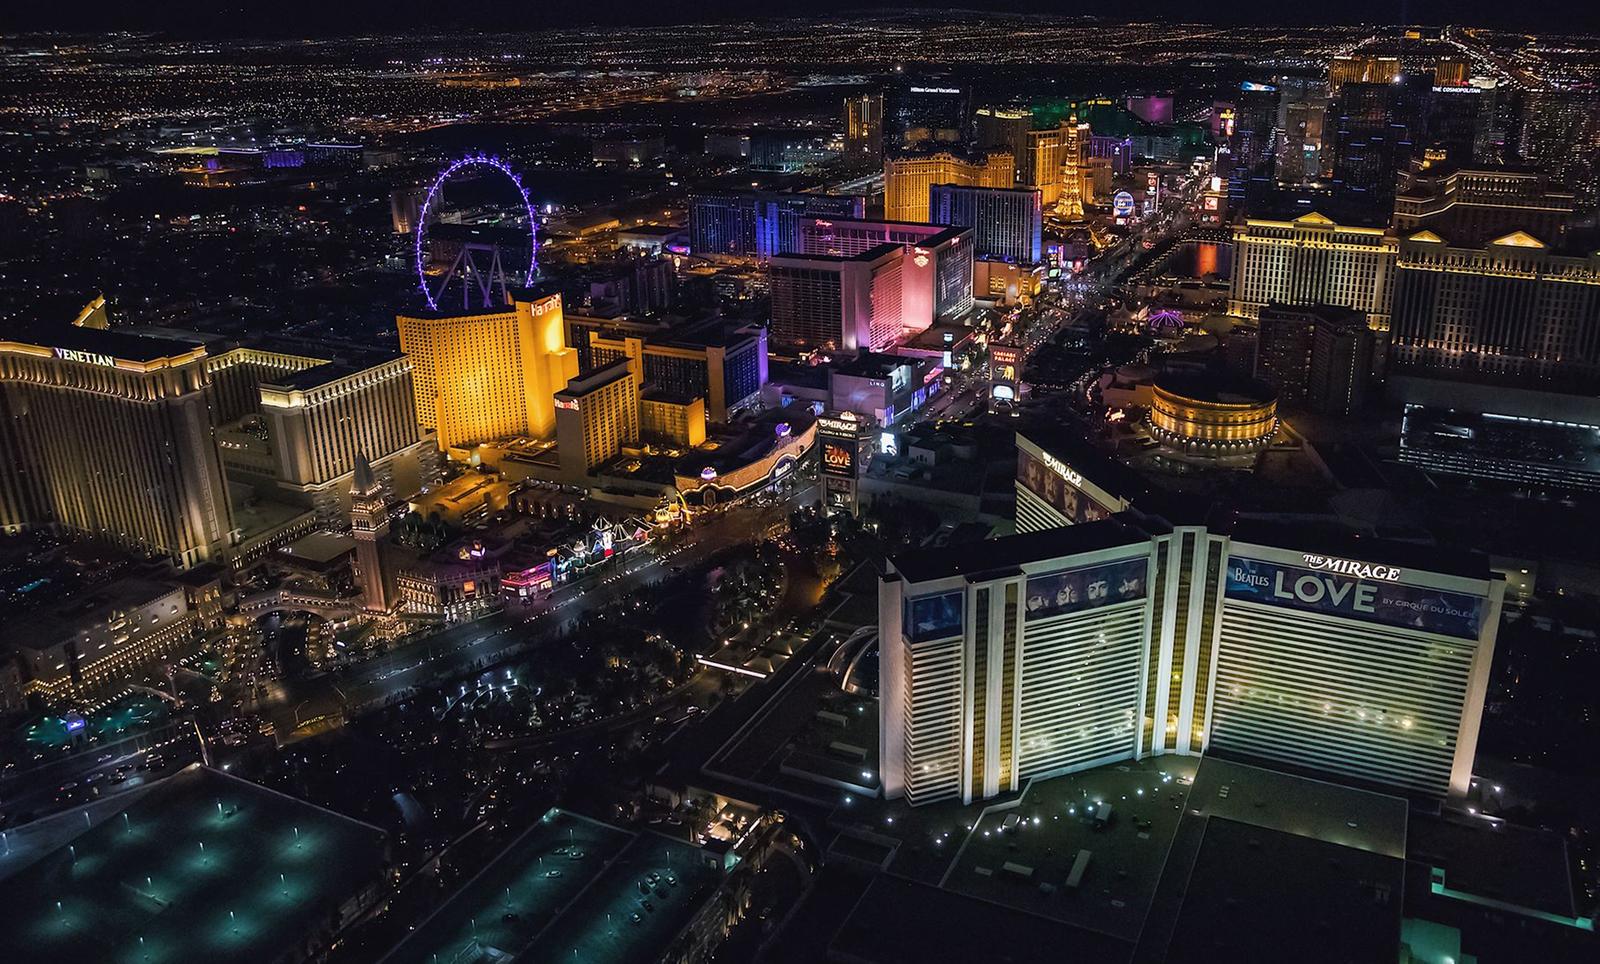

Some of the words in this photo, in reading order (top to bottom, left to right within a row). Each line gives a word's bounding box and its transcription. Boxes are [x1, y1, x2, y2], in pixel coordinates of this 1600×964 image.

[55, 347, 114, 367] VENETIAN
[821, 420, 857, 431] MIRAGE
[825, 454, 851, 466] LOVE
[1045, 456, 1082, 487] MIRAGE
[1303, 554, 1324, 566] THE
[1309, 557, 1400, 581] MIRAGE
[1274, 571, 1378, 613] LOVE
[1395, 600, 1429, 611] CIRQUE
[1431, 606, 1444, 614] DU
